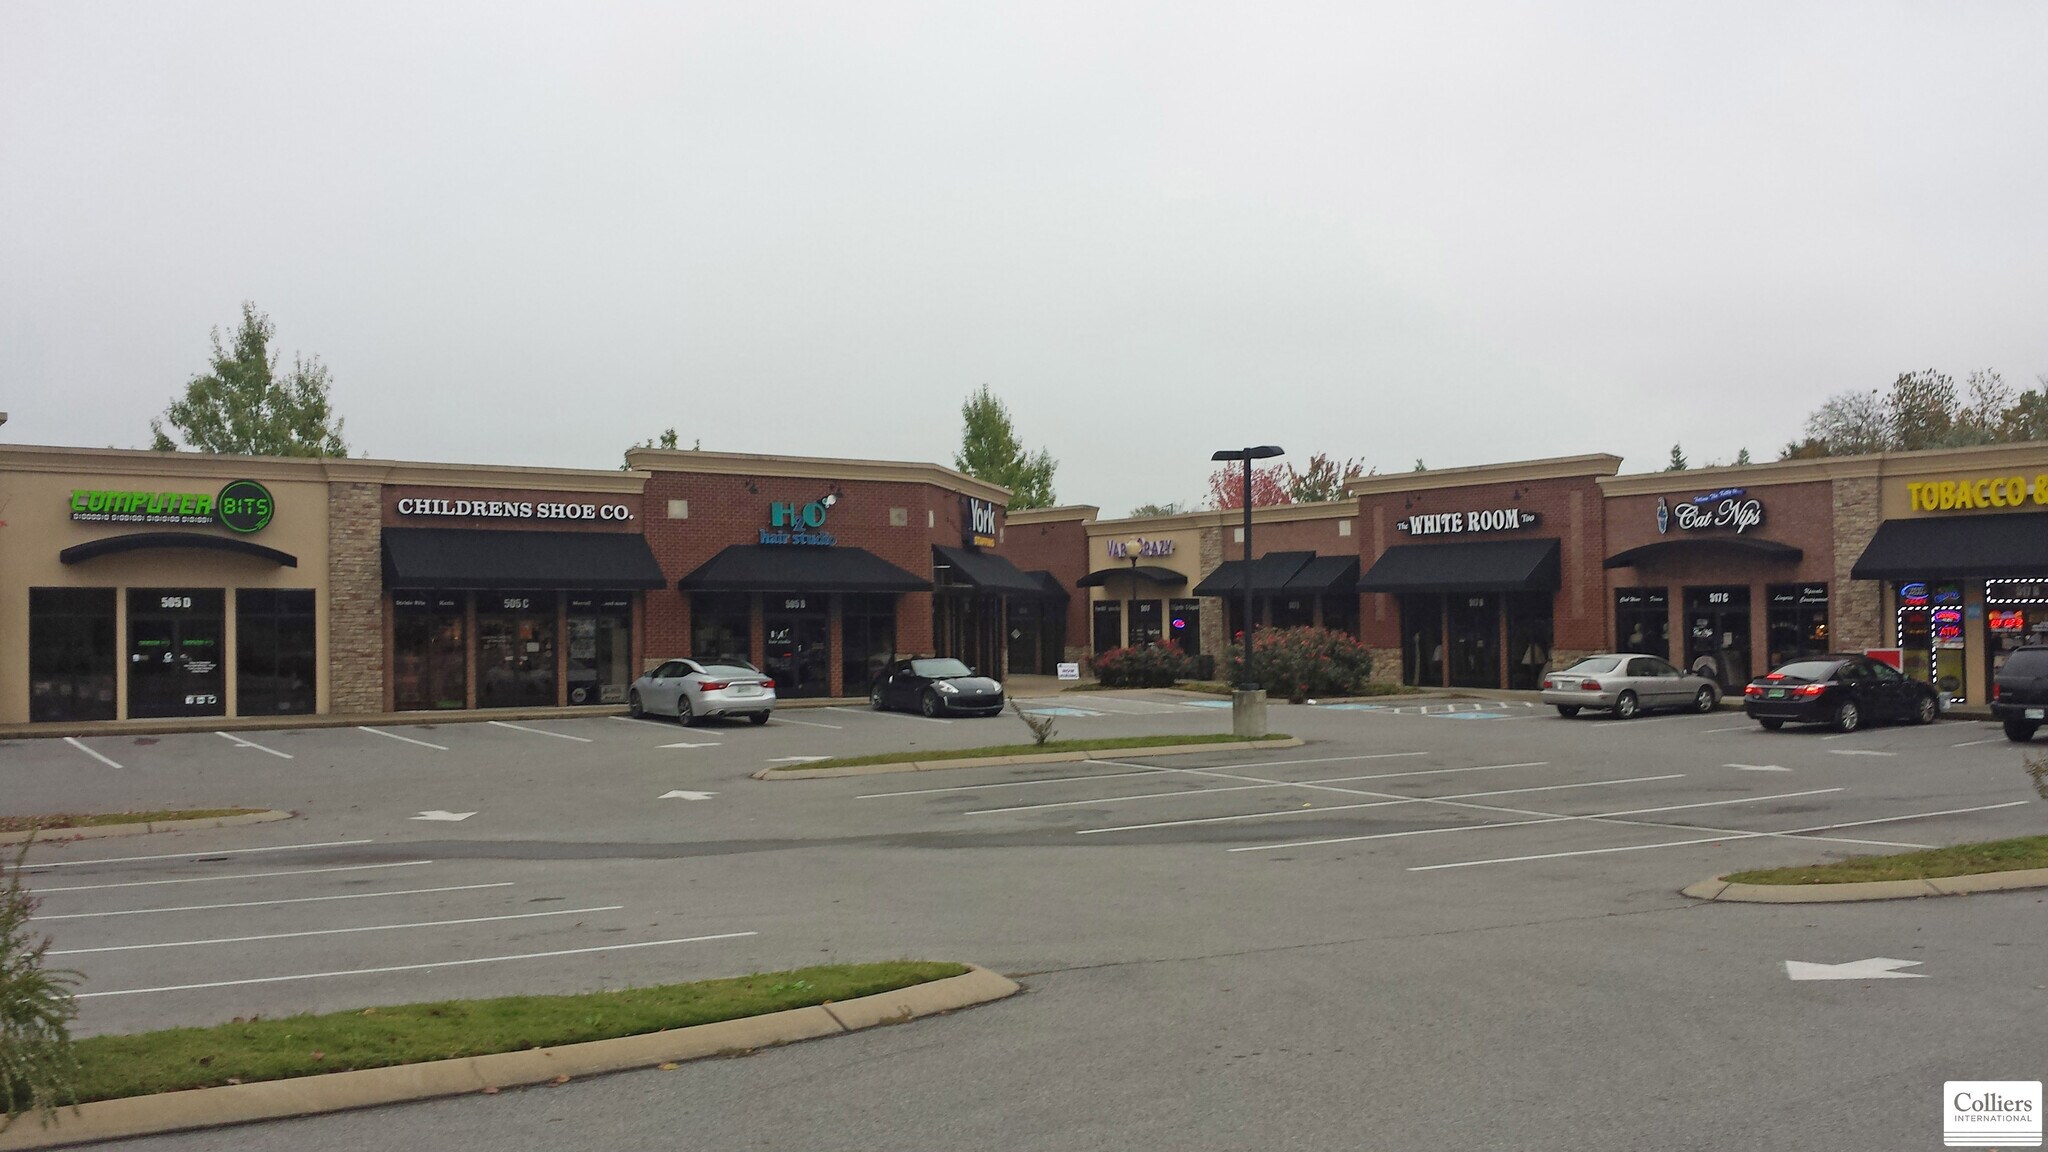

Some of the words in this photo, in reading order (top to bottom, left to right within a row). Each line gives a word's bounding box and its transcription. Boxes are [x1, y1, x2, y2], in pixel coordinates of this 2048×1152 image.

[71, 490, 213, 515] COMPUTER
[1907, 477, 2027, 511] TOBACCO
[2033, 474, 2048, 505] &
[223, 498, 269, 516] BITS
[398, 498, 532, 518] CHILDRENS
[536, 502, 596, 519] SHOE
[600, 505, 635, 520] CO.
[970, 498, 996, 535] York
[1674, 503, 1712, 530] Cat
[1714, 498, 1762, 534] Nips
[1396, 521, 1409, 531] The
[1409, 512, 1463, 535] WHITE
[1467, 508, 1520, 532] ROOM
[759, 528, 790, 545] hair
[791, 531, 838, 546] studio
[161, 596, 182, 608] 505
[182, 597, 192, 608] D
[503, 598, 522, 609] 505
[522, 598, 530, 609] C
[1940, 626, 1959, 636] ATM
